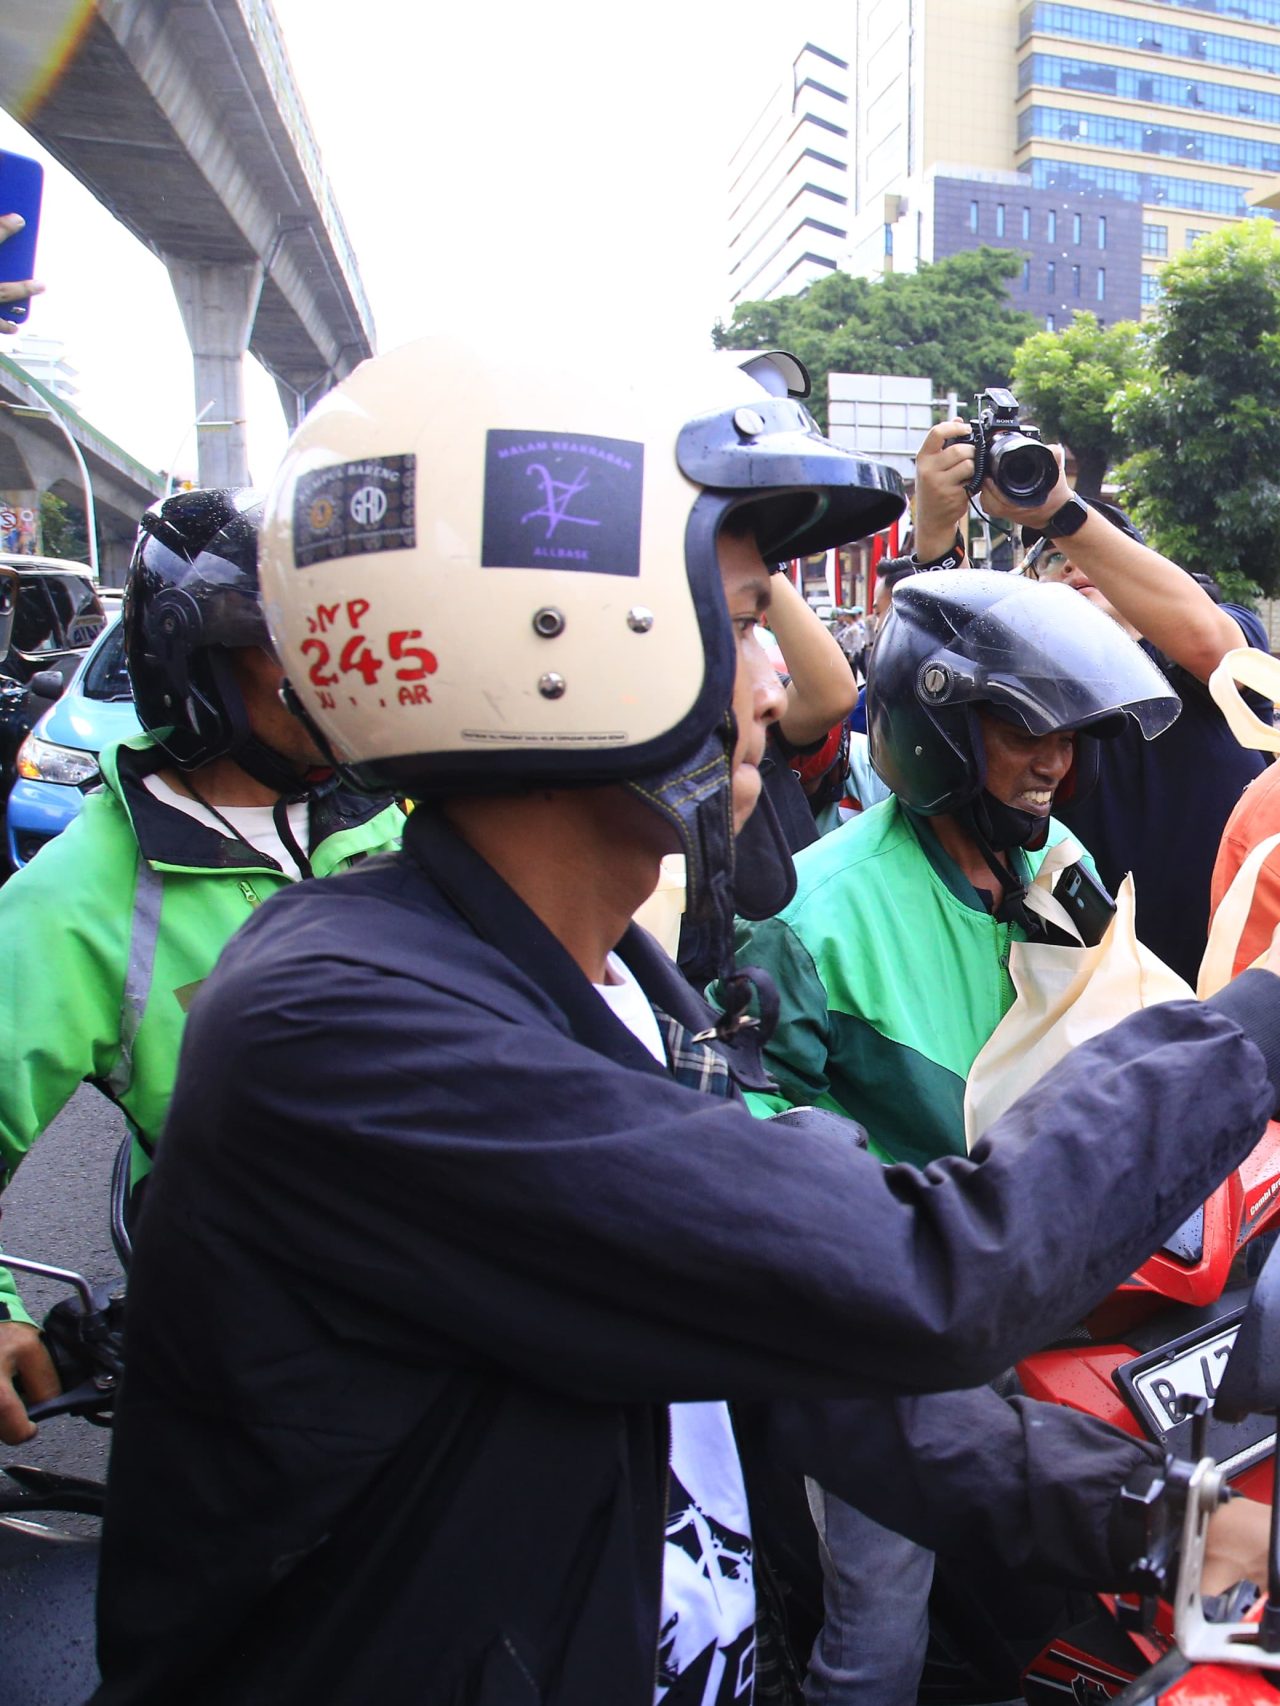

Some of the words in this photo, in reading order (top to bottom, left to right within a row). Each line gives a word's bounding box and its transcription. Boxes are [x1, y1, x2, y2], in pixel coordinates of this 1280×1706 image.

[498, 441, 547, 458] MALAM
[534, 547, 588, 560] ALLBASE
[300, 629, 438, 686] 245
[1250, 1188, 1271, 1217] Combi
[1150, 1376, 1187, 1425] B
